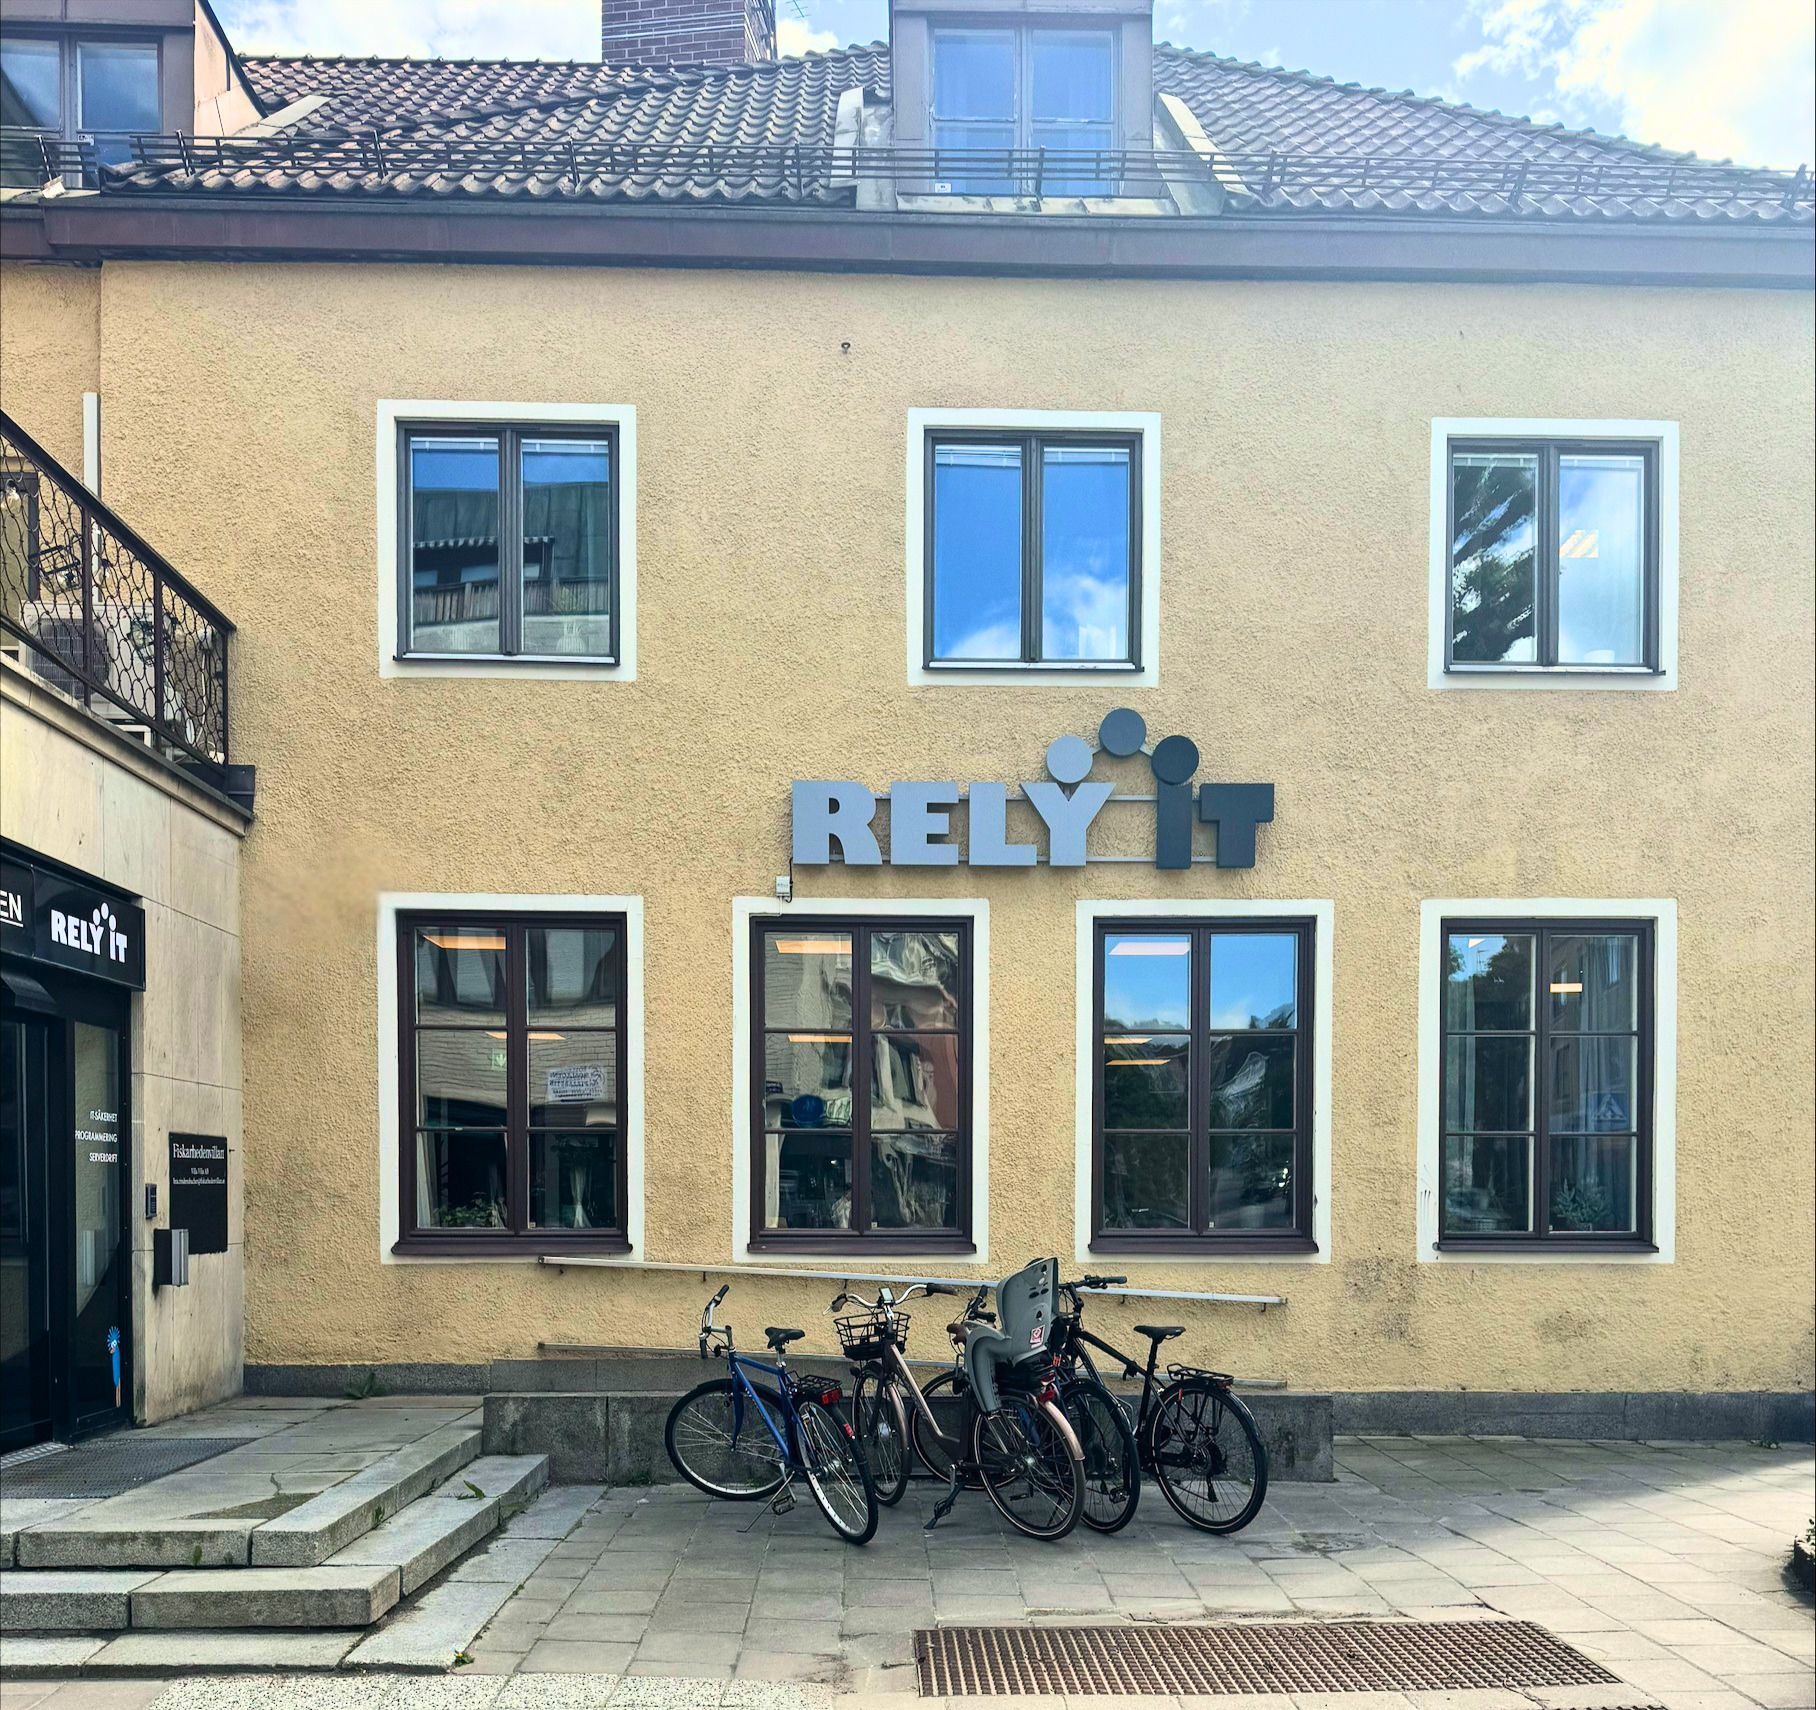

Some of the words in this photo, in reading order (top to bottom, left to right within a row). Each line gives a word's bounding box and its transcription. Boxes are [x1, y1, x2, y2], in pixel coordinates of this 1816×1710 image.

[792, 780, 1116, 867] RELY
[51, 909, 104, 955] RELY
[74, 1130, 118, 1143] PROGRAMMERING
[88, 1152, 118, 1163] SERVERDRIFT
